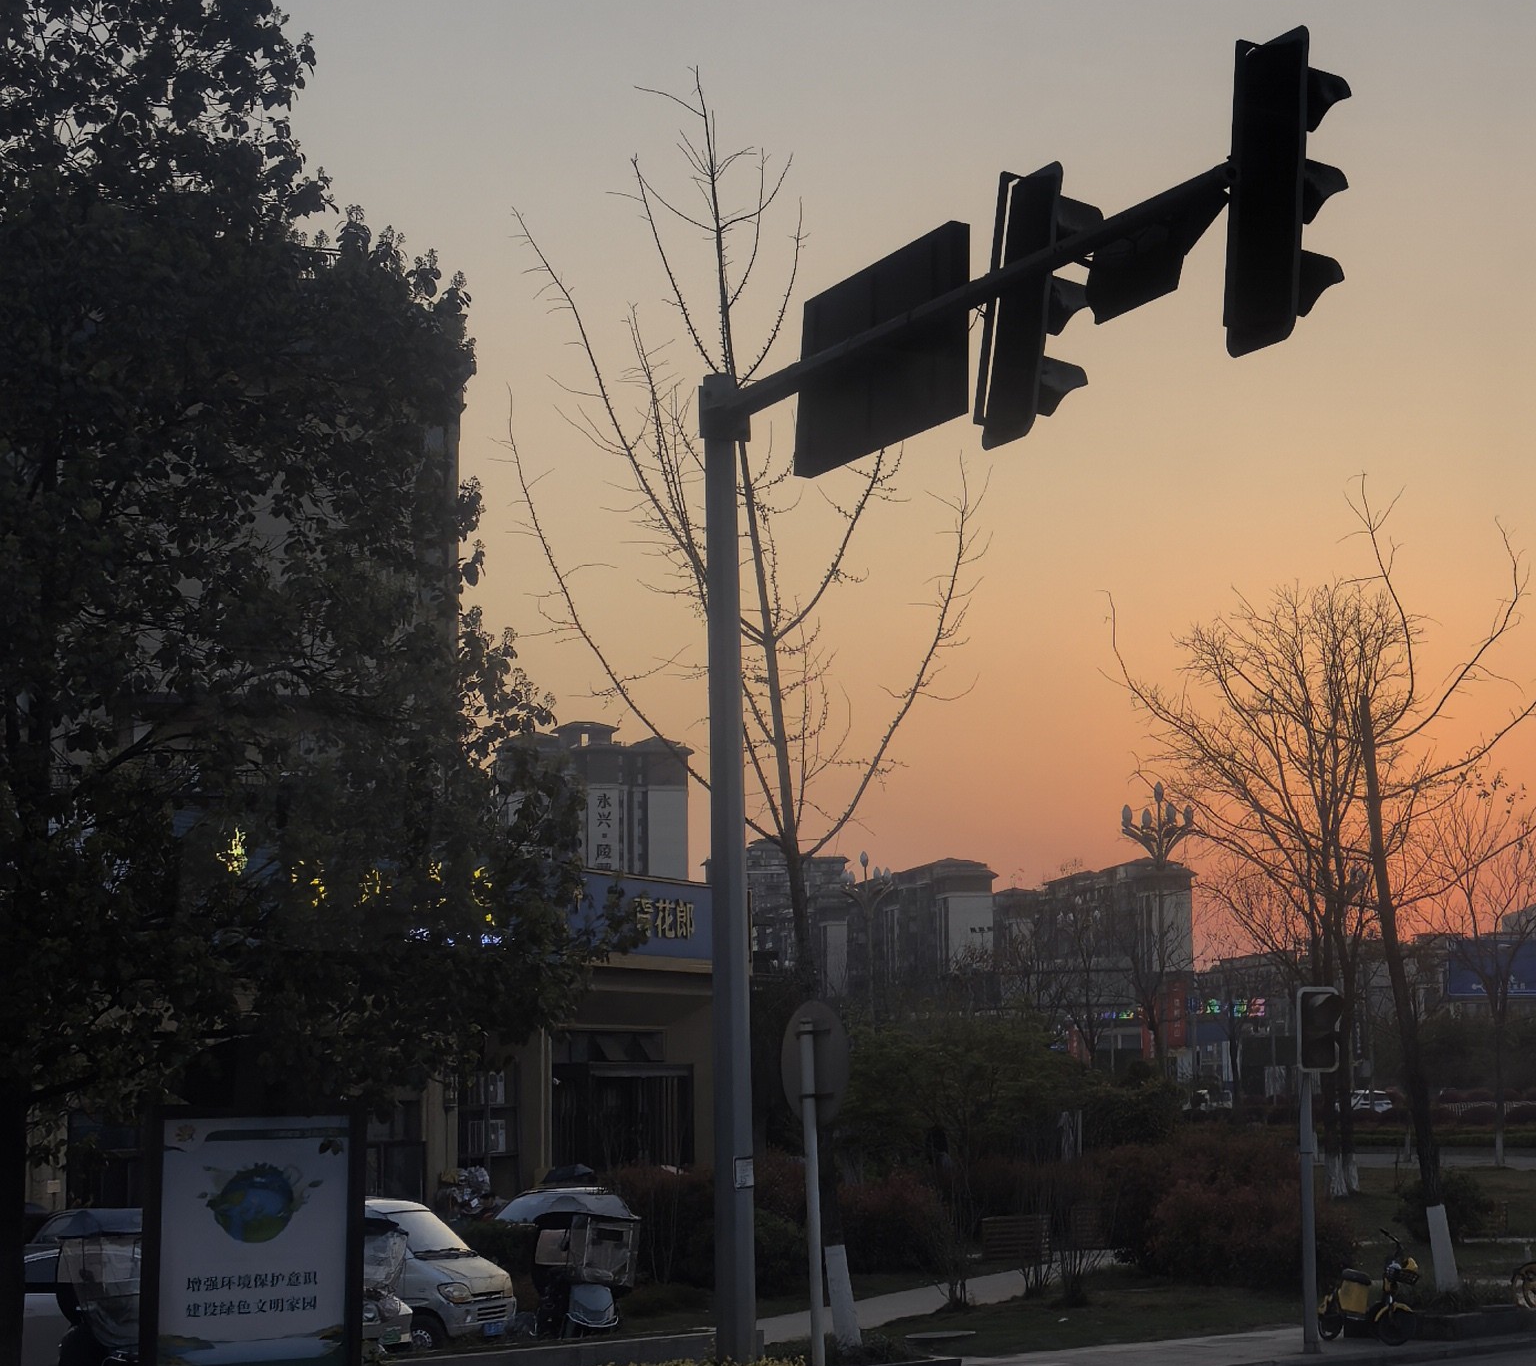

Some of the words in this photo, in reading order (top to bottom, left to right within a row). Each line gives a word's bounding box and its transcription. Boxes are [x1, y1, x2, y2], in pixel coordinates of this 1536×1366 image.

[186, 1270, 318, 1292] 增强环境保护意识
[186, 1295, 318, 1318] 建设绿色文明家园
